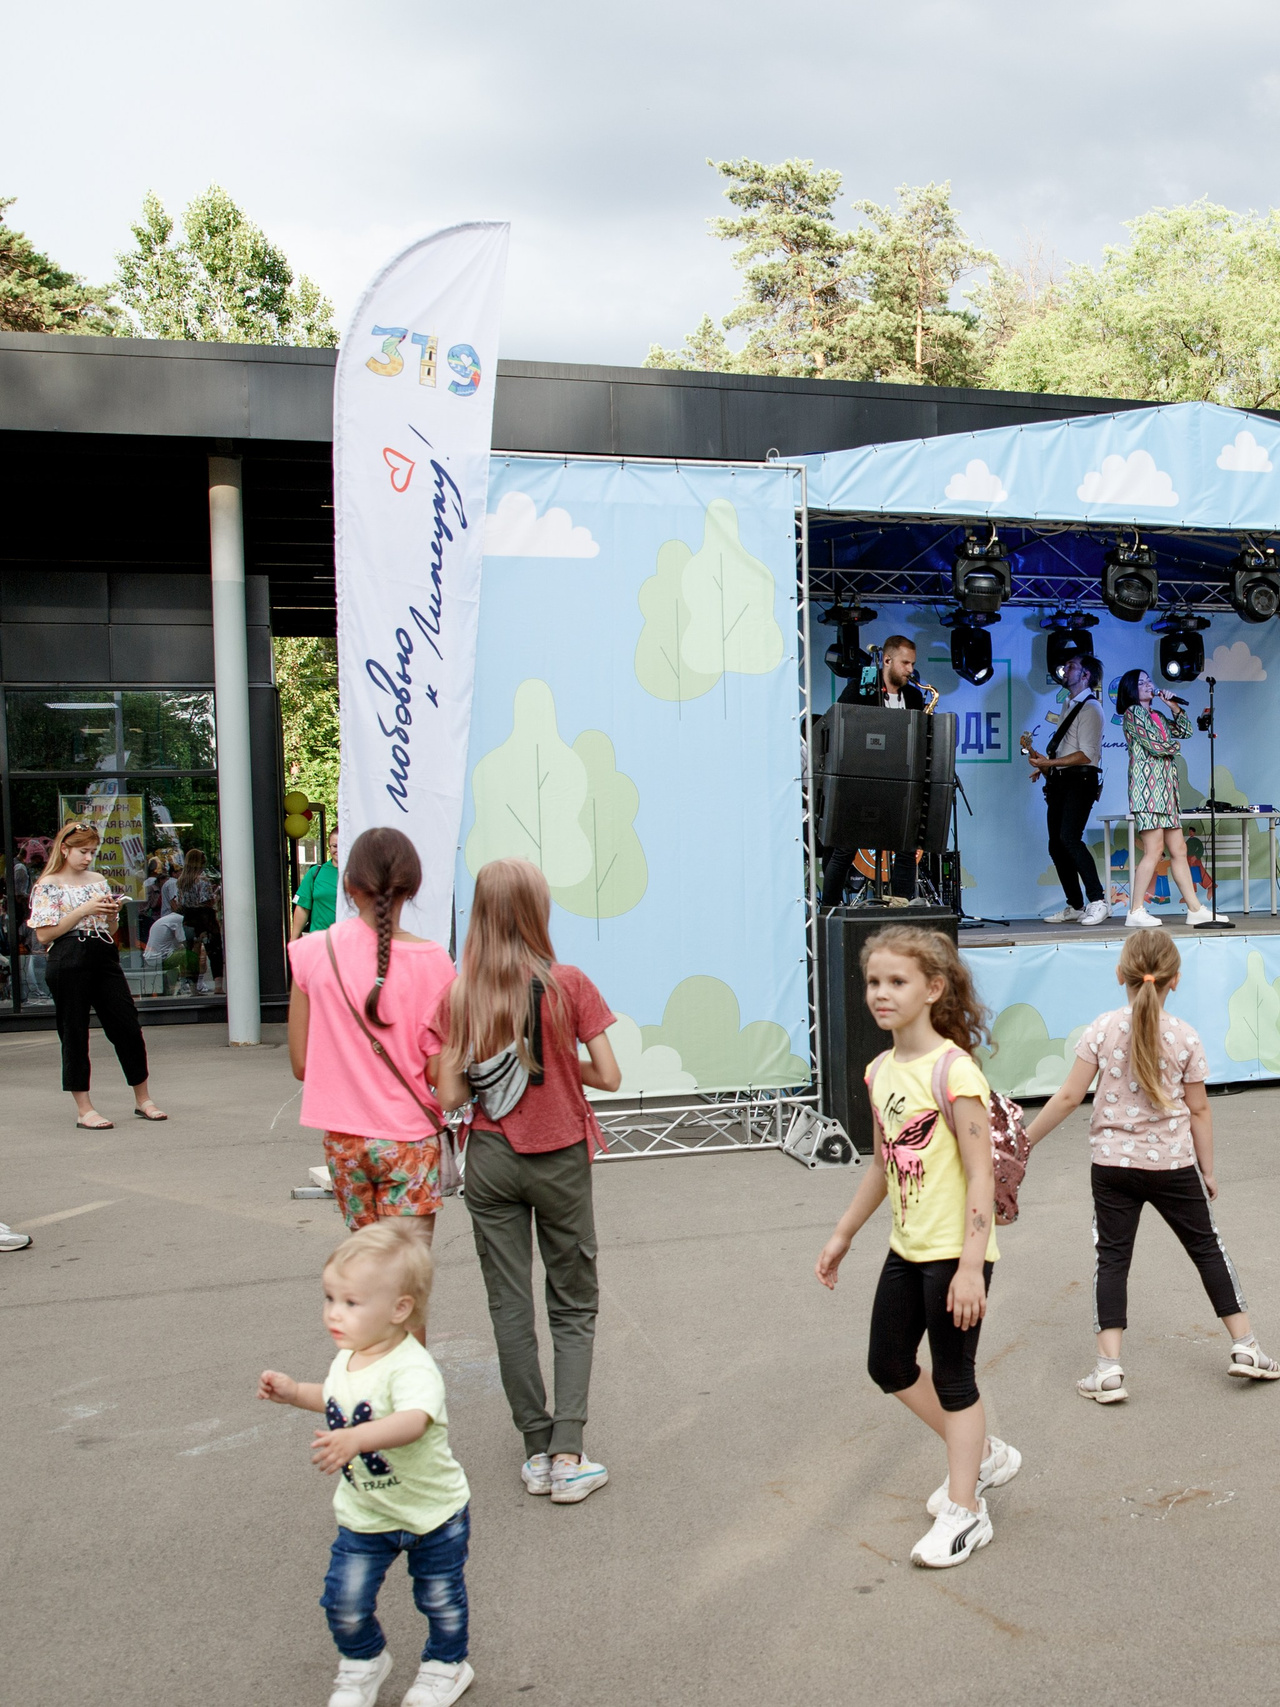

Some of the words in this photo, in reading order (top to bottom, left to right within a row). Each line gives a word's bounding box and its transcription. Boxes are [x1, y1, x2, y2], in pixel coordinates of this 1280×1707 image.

[365, 325, 482, 397] 319
[118, 820, 142, 828] ВАТА
[101, 836, 120, 845] ОФЕ
[97, 868, 130, 877] АРИКИ
